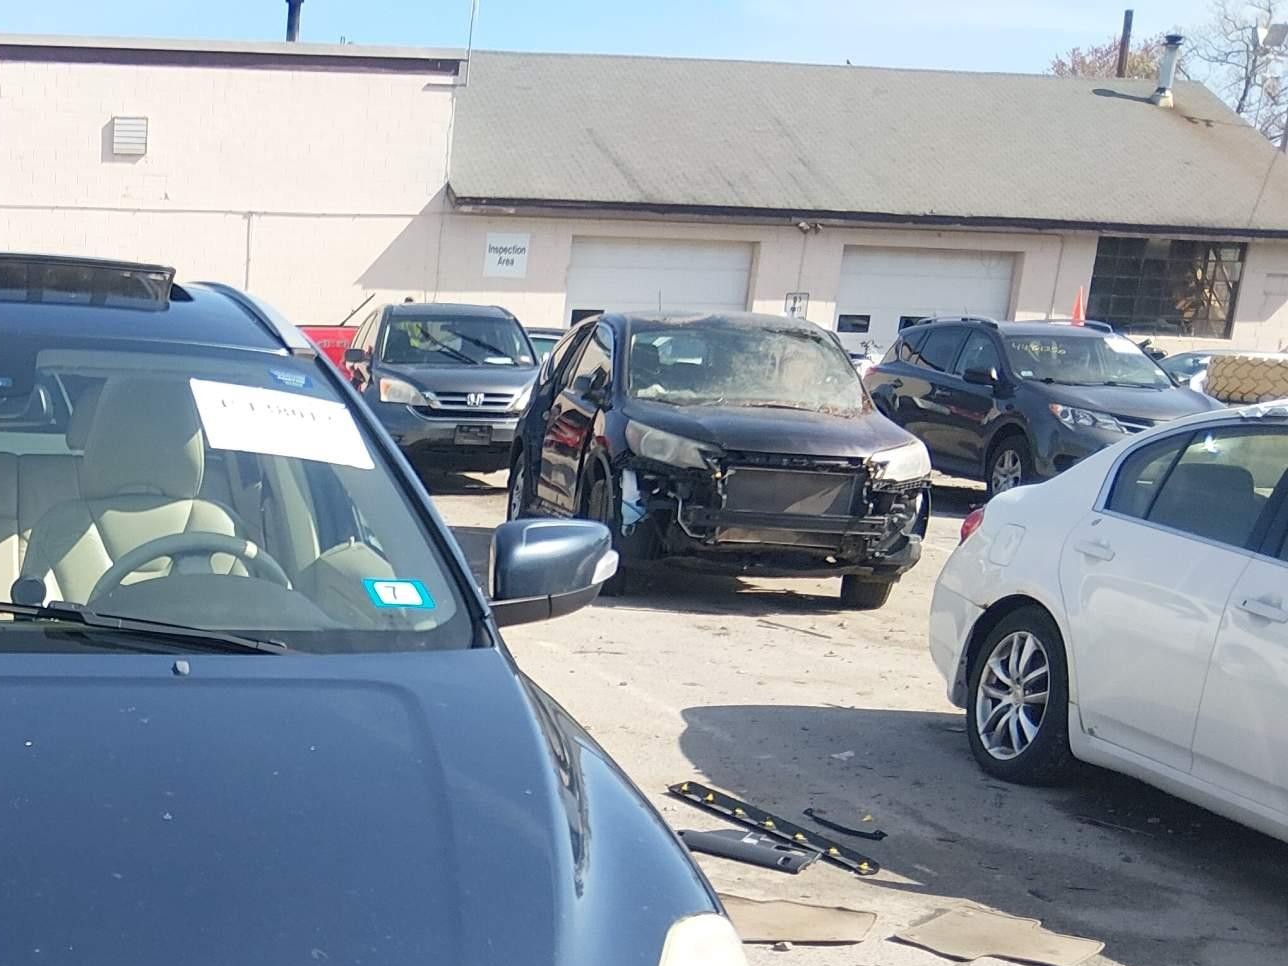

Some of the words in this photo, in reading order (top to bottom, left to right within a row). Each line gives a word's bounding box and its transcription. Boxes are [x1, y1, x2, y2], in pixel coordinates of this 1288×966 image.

[488, 243, 526, 256] Inspection
[497, 256, 515, 266] Area
[383, 585, 398, 600] 7
